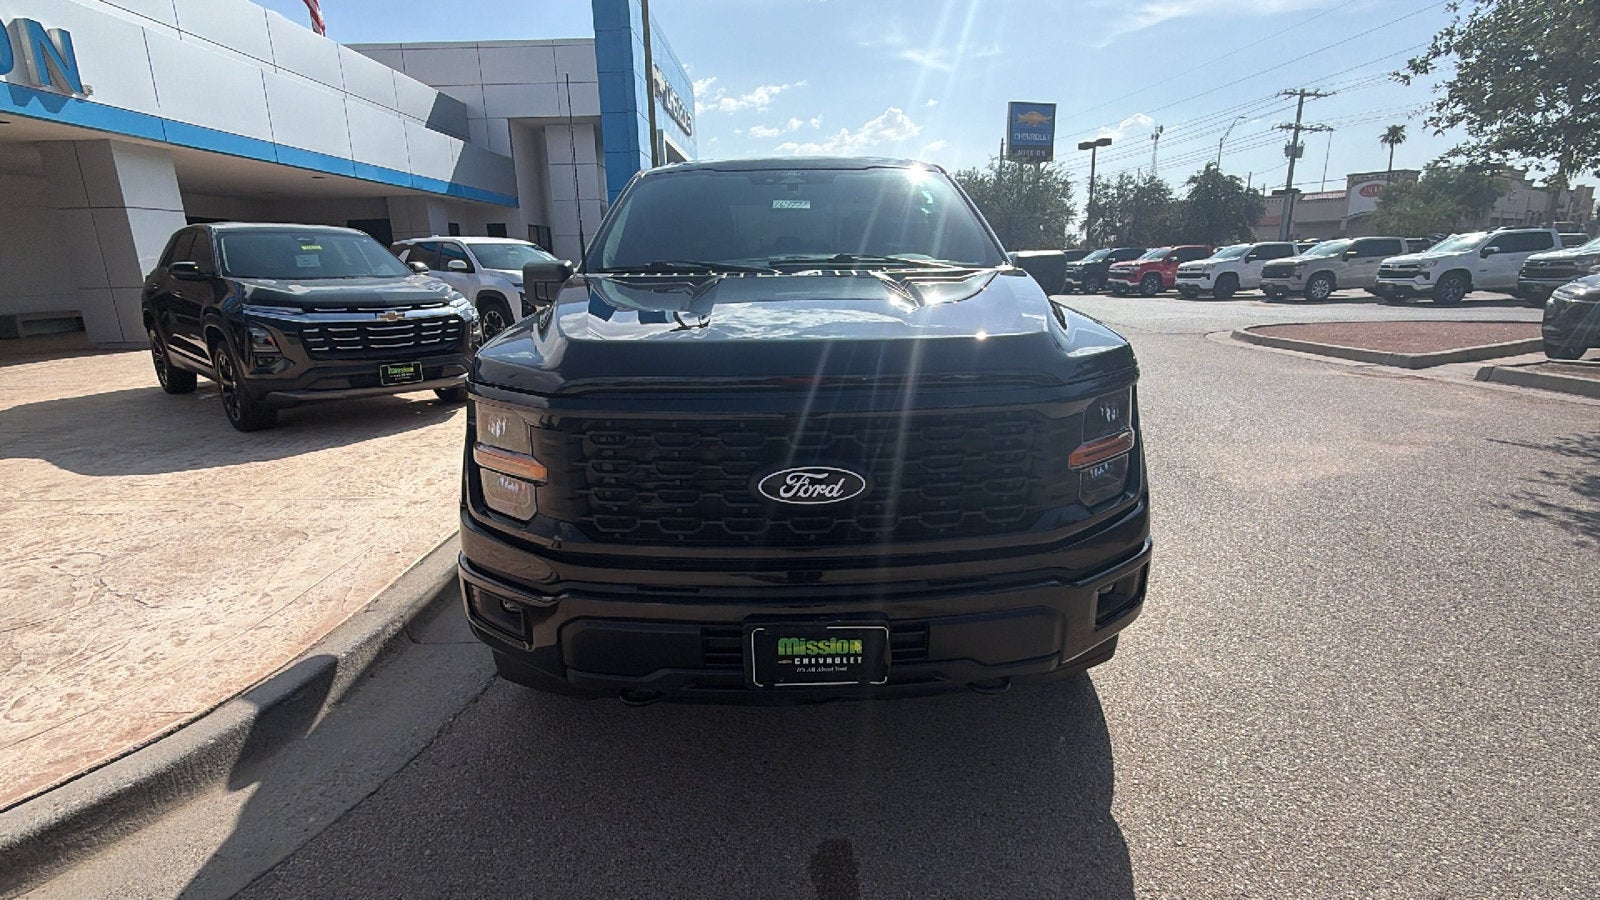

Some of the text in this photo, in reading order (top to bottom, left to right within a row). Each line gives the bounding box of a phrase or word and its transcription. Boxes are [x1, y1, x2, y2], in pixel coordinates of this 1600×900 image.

[0, 17, 83, 94] N
[1014, 132, 1050, 141] CHEVROLET
[780, 472, 846, 498] Ford
[778, 637, 862, 656] Mission
[794, 656, 862, 665] CHEVROLET
